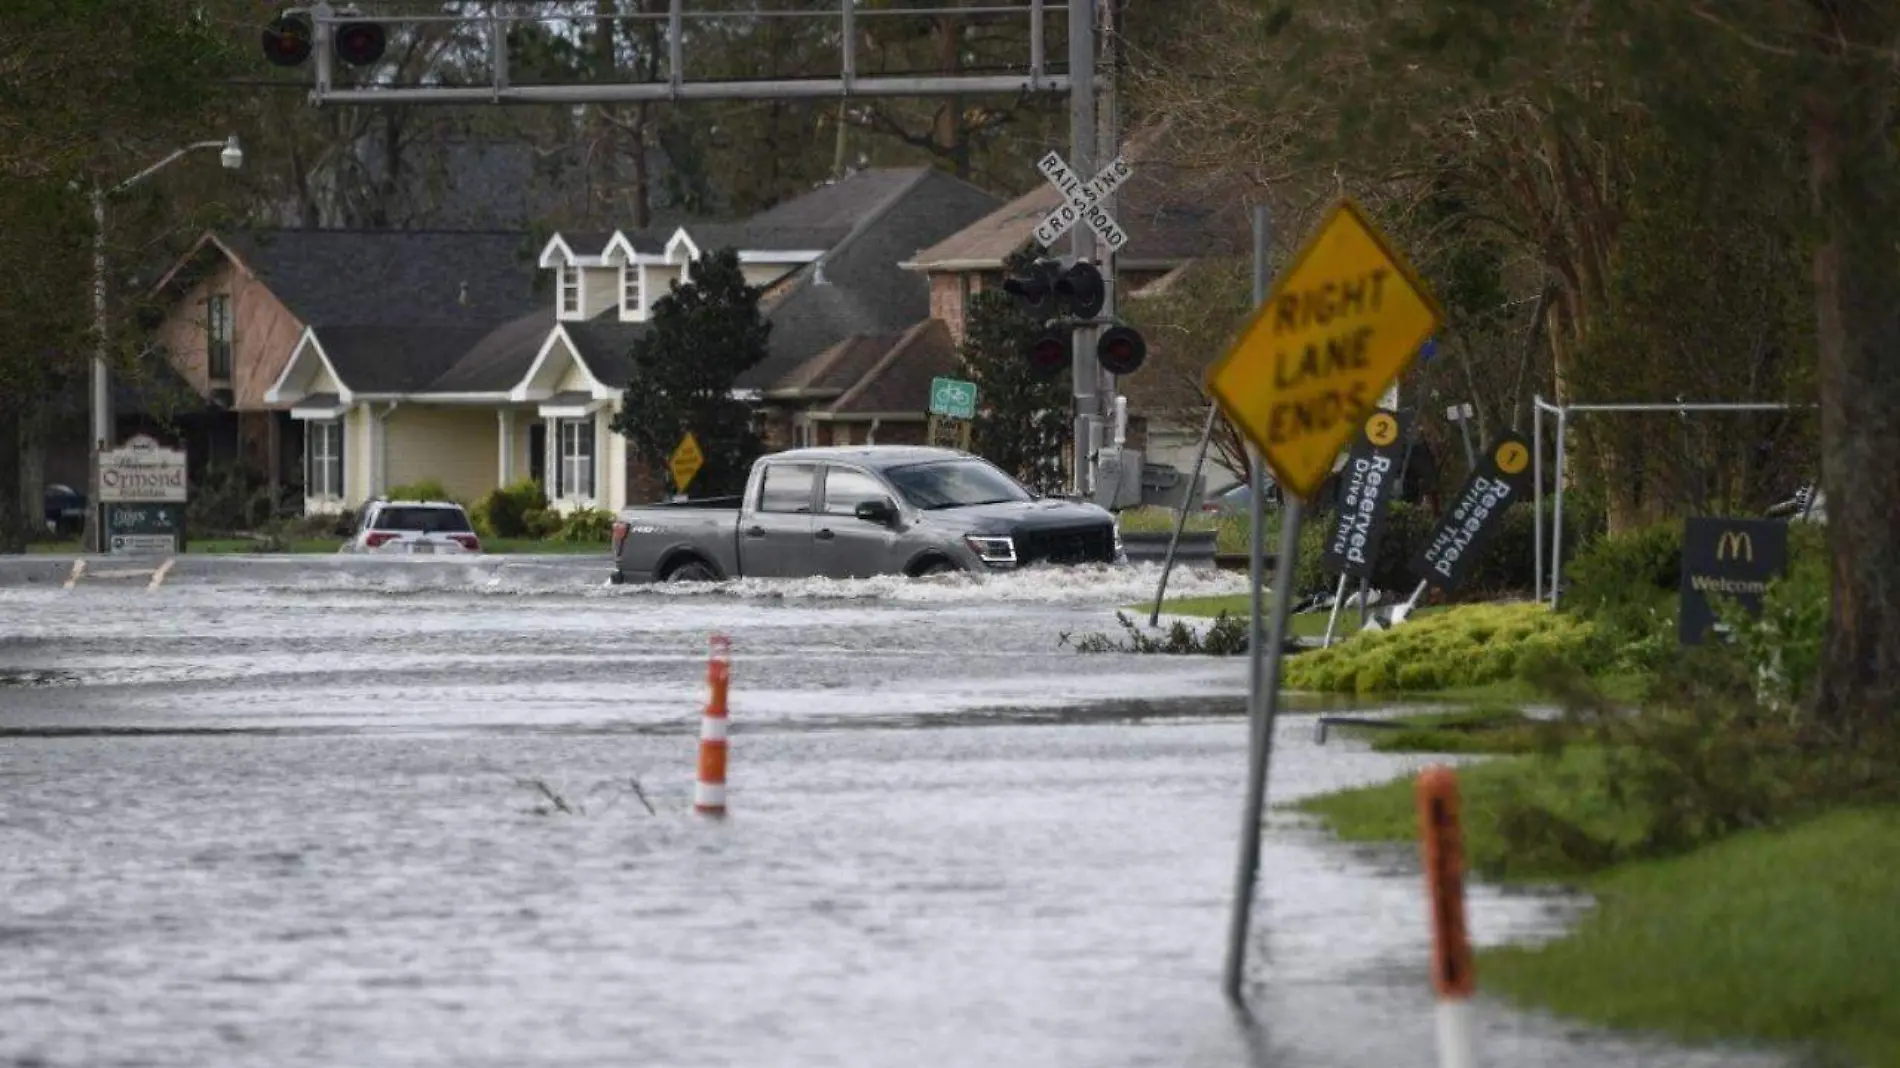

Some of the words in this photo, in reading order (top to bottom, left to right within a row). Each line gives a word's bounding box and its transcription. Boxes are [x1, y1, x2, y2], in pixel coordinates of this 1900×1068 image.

[1038, 162, 1128, 240] CROSSING
[1042, 155, 1077, 197] RAIL
[1088, 205, 1122, 246] ROAD
[1274, 267, 1391, 338] RIGHT
[1274, 325, 1374, 391] LANE
[1268, 380, 1367, 443] ENDS
[1375, 420, 1389, 438] 2
[103, 469, 182, 489] Ormond
[1346, 458, 1370, 506] Drive
[1454, 476, 1491, 521] Drive
[1334, 514, 1356, 554] Thru
[1347, 455, 1391, 564] Reserved
[1435, 479, 1512, 578] Reserved
[1425, 526, 1459, 561] Thru
[1691, 575, 1766, 594] Welcom
